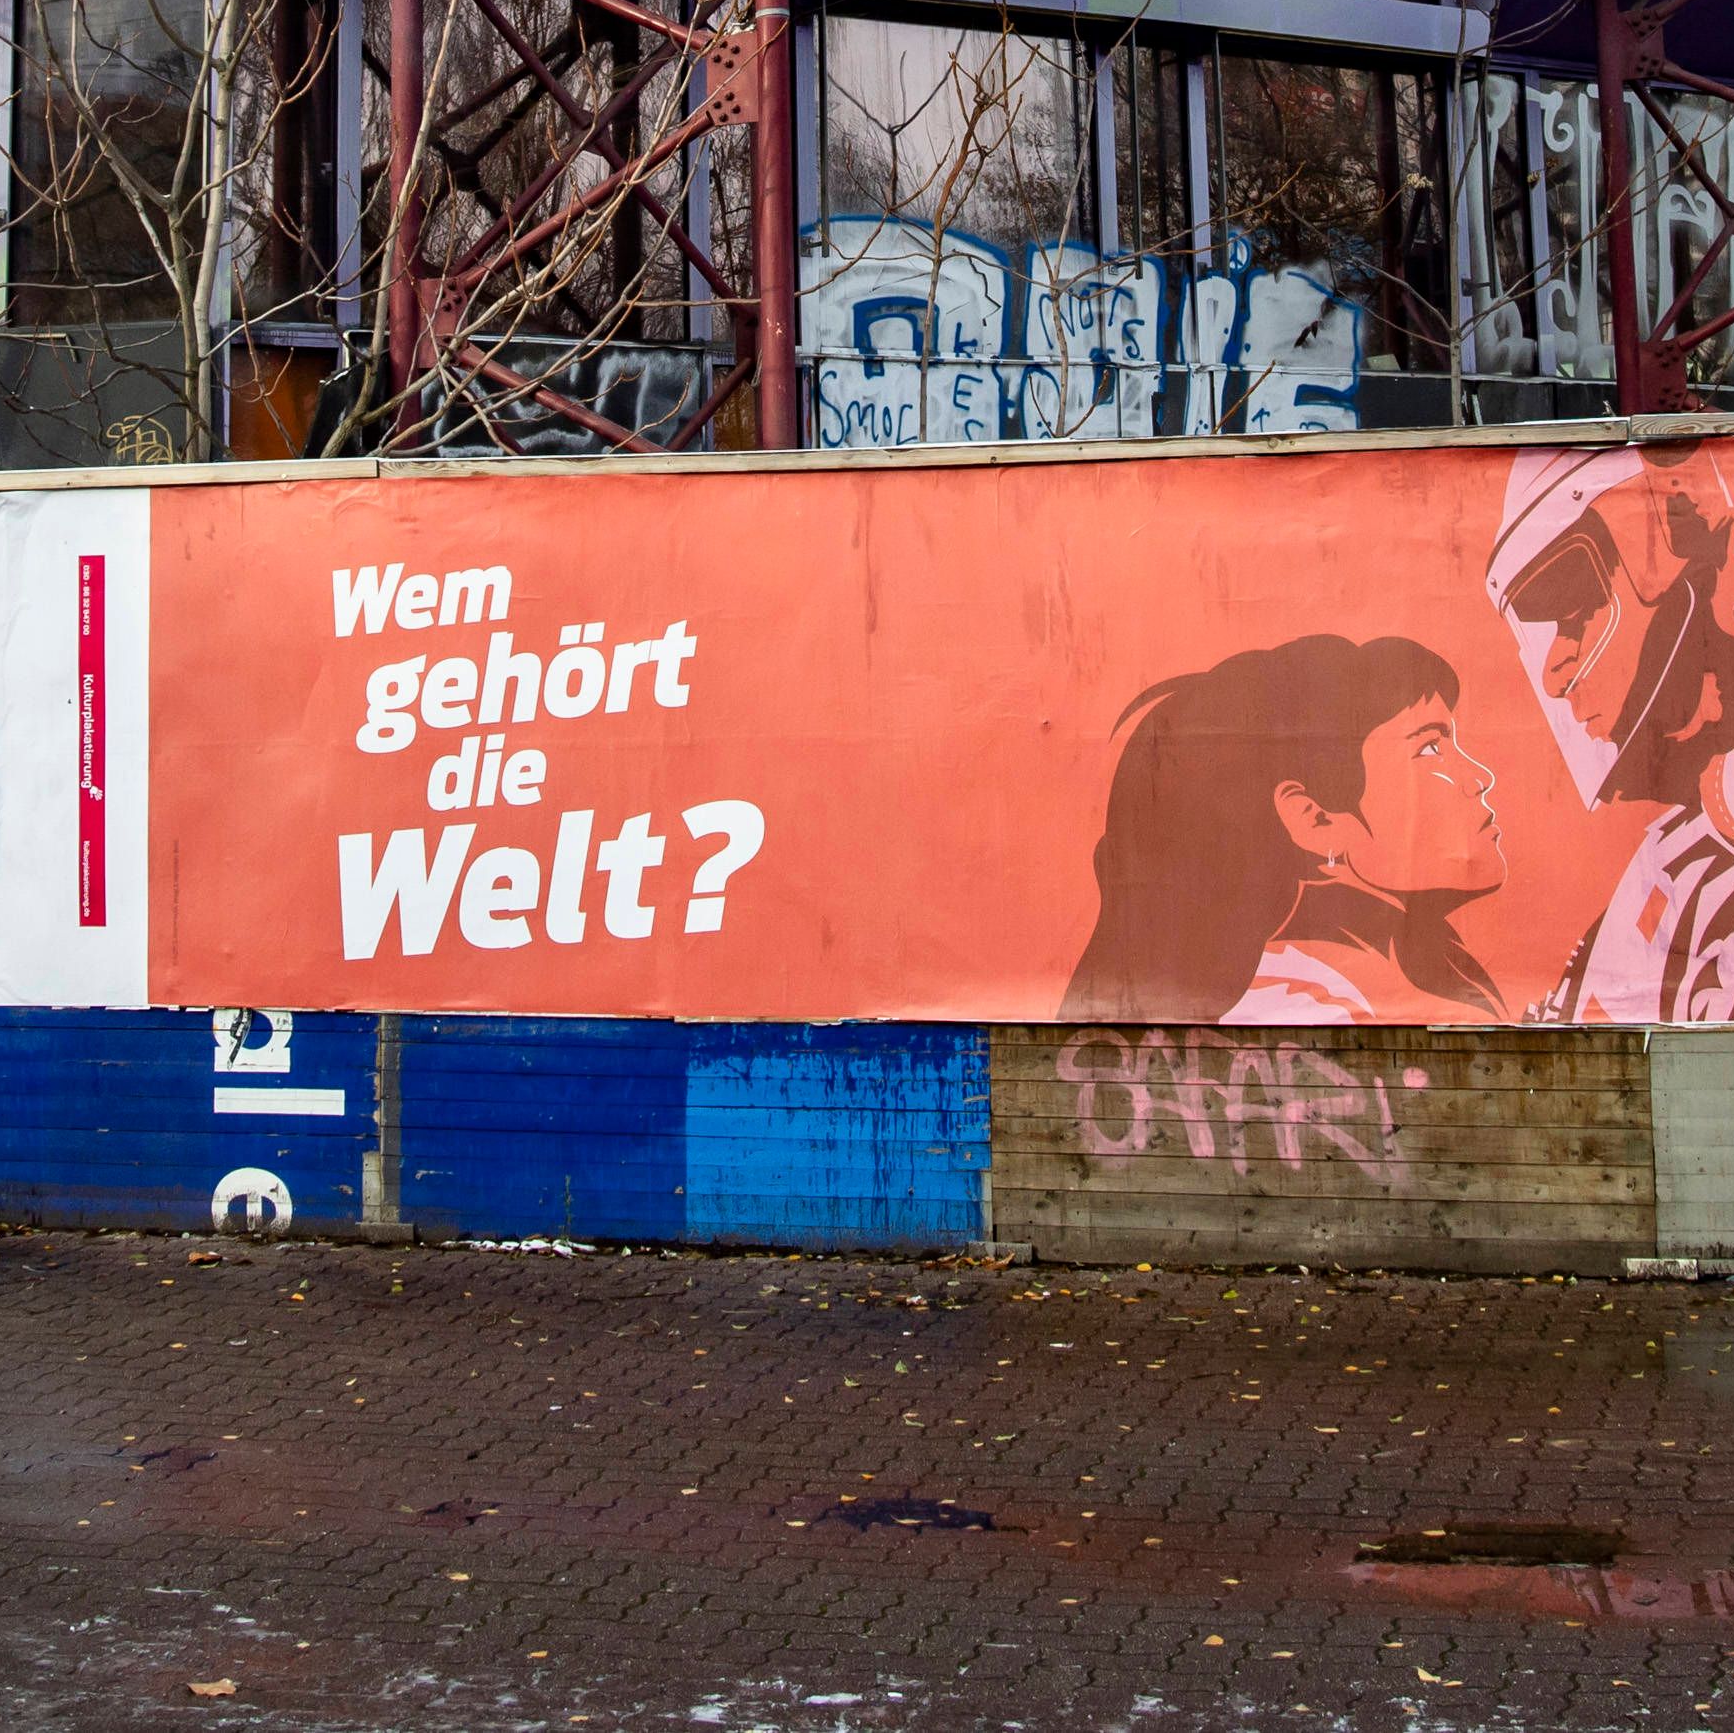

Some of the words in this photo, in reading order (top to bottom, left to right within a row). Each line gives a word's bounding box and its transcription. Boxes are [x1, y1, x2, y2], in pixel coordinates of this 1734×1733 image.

[331, 562, 513, 638] Wem
[80, 674, 95, 789] Kulturplakatierung
[355, 619, 698, 754] gehört
[426, 733, 547, 812] die
[338, 799, 766, 961] Welt?
